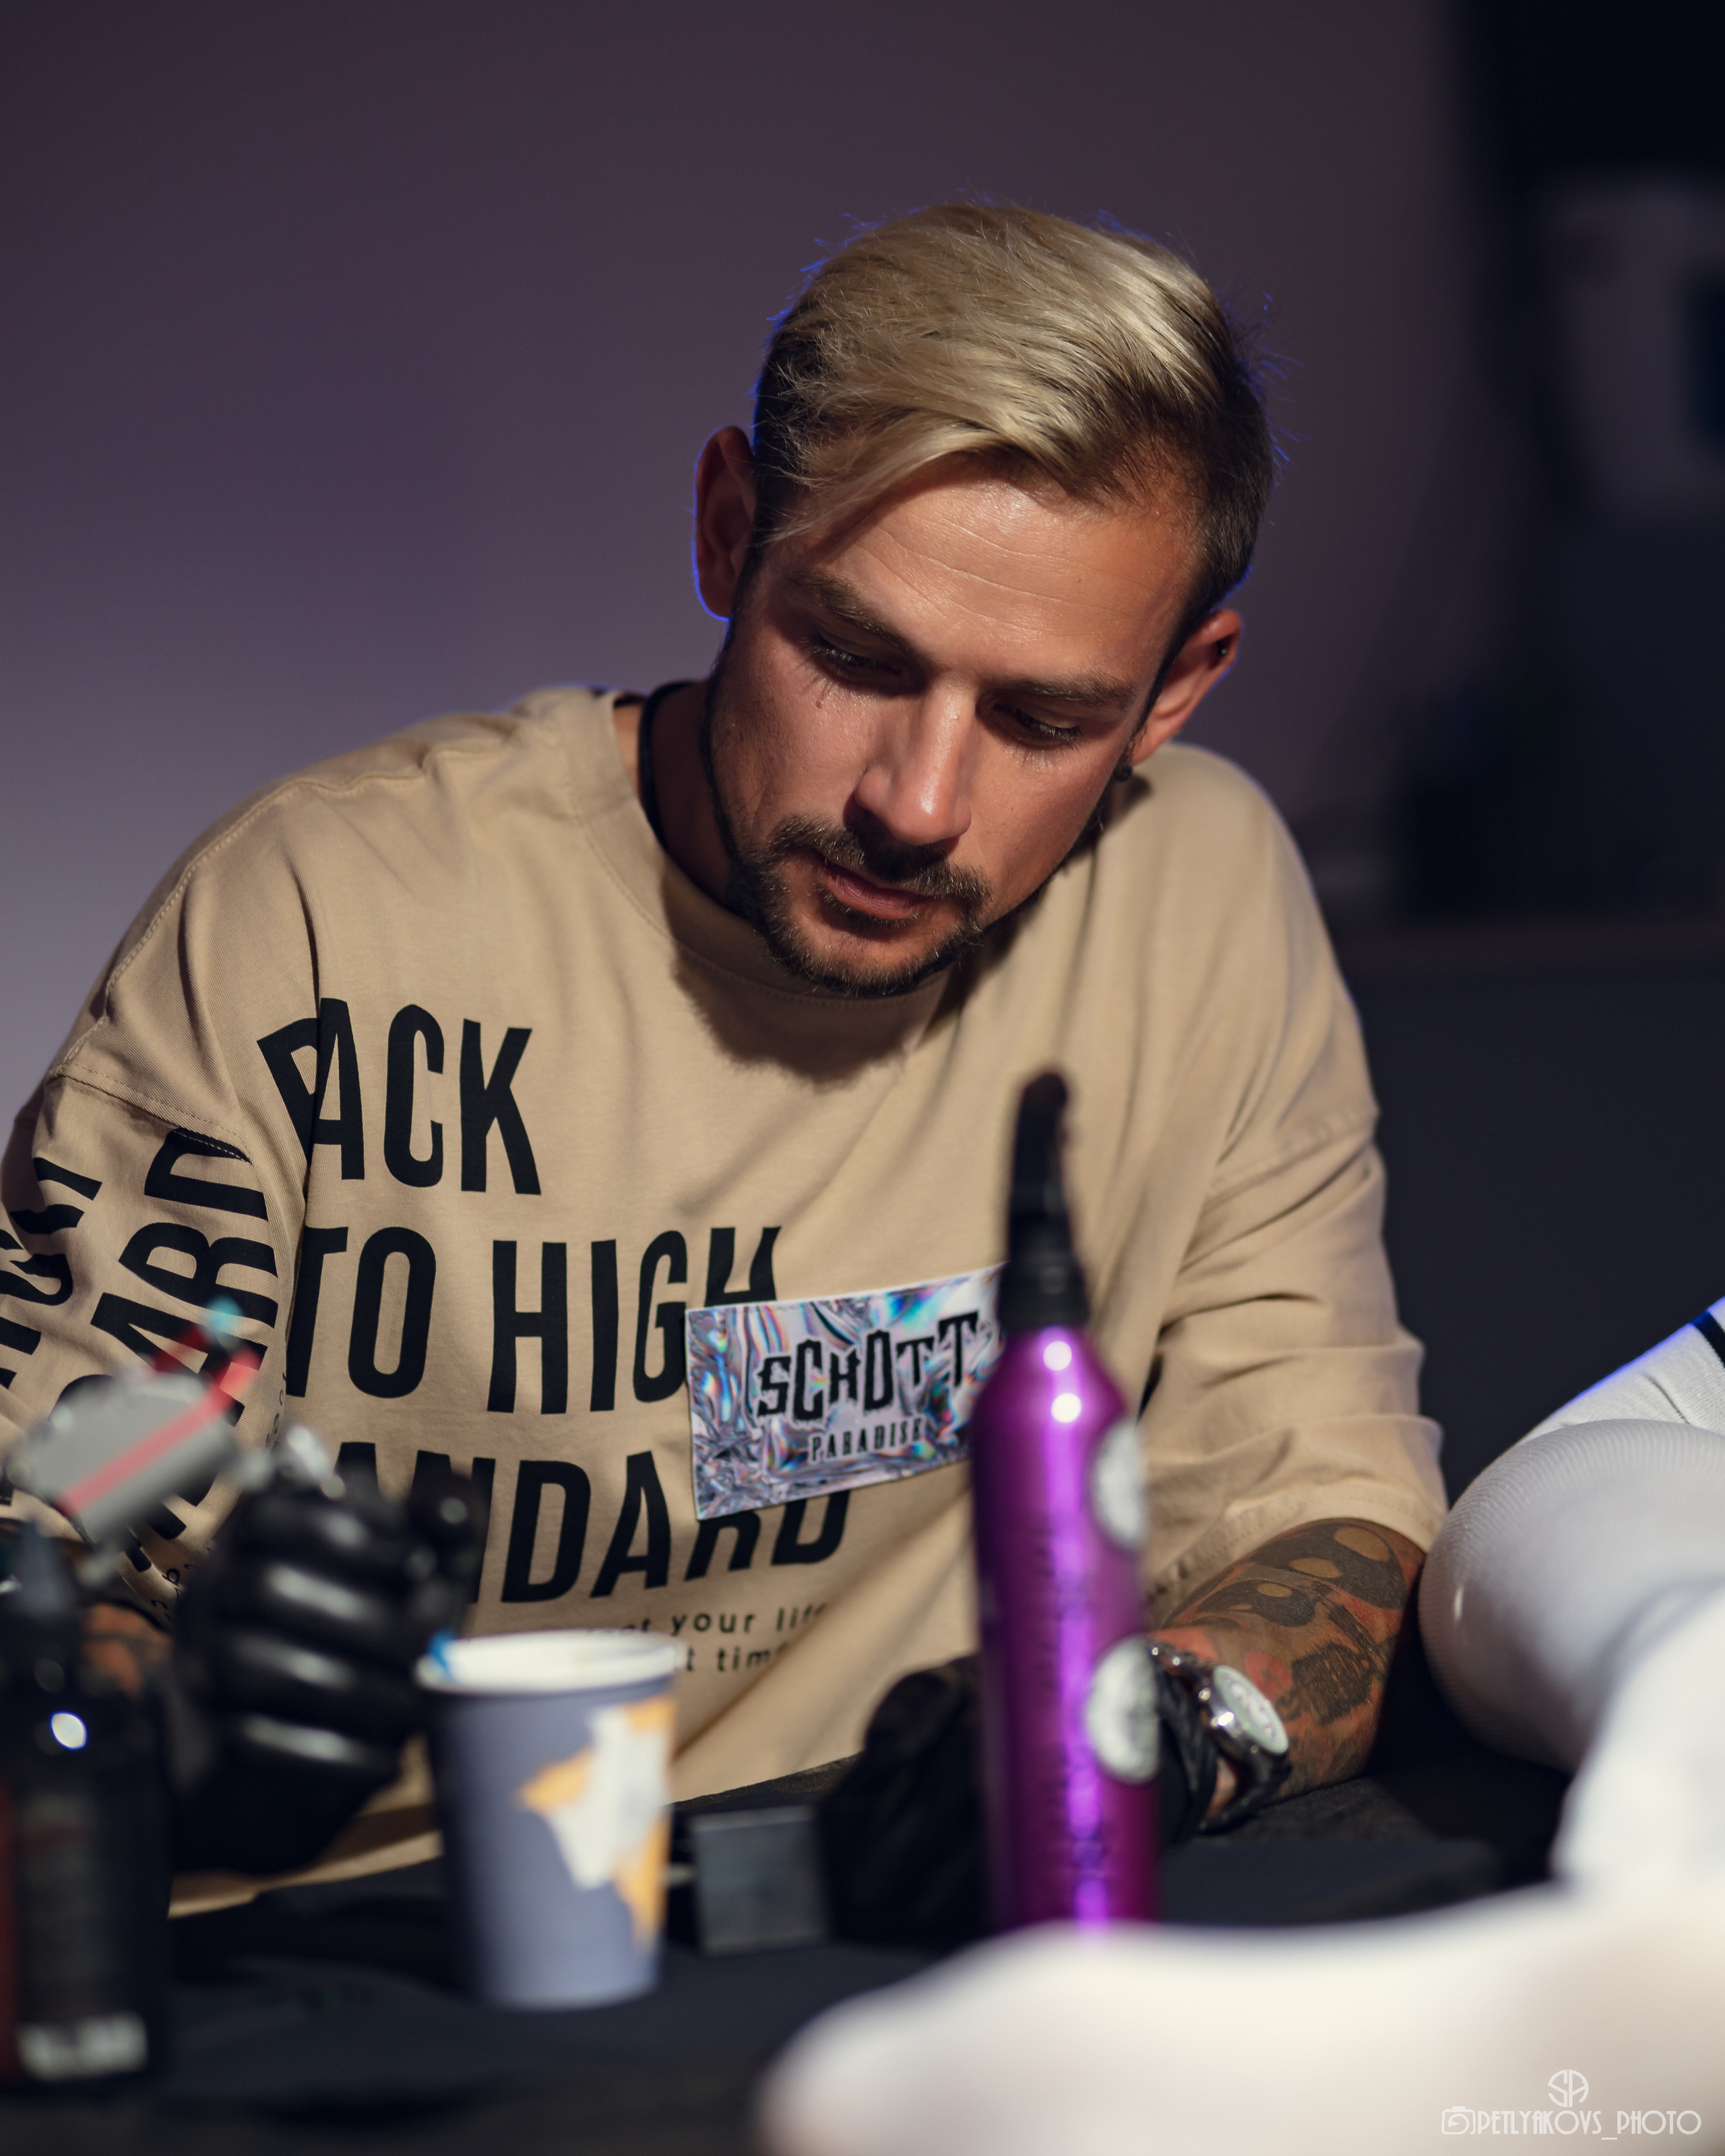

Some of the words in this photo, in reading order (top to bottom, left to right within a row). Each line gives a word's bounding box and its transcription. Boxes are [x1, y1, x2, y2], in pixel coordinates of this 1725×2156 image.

[286, 1226, 437, 1399] TO
[756, 1310, 980, 1422] SCHOTT
[811, 1417, 923, 1462] PARADISE
[671, 1612, 755, 1637] your
